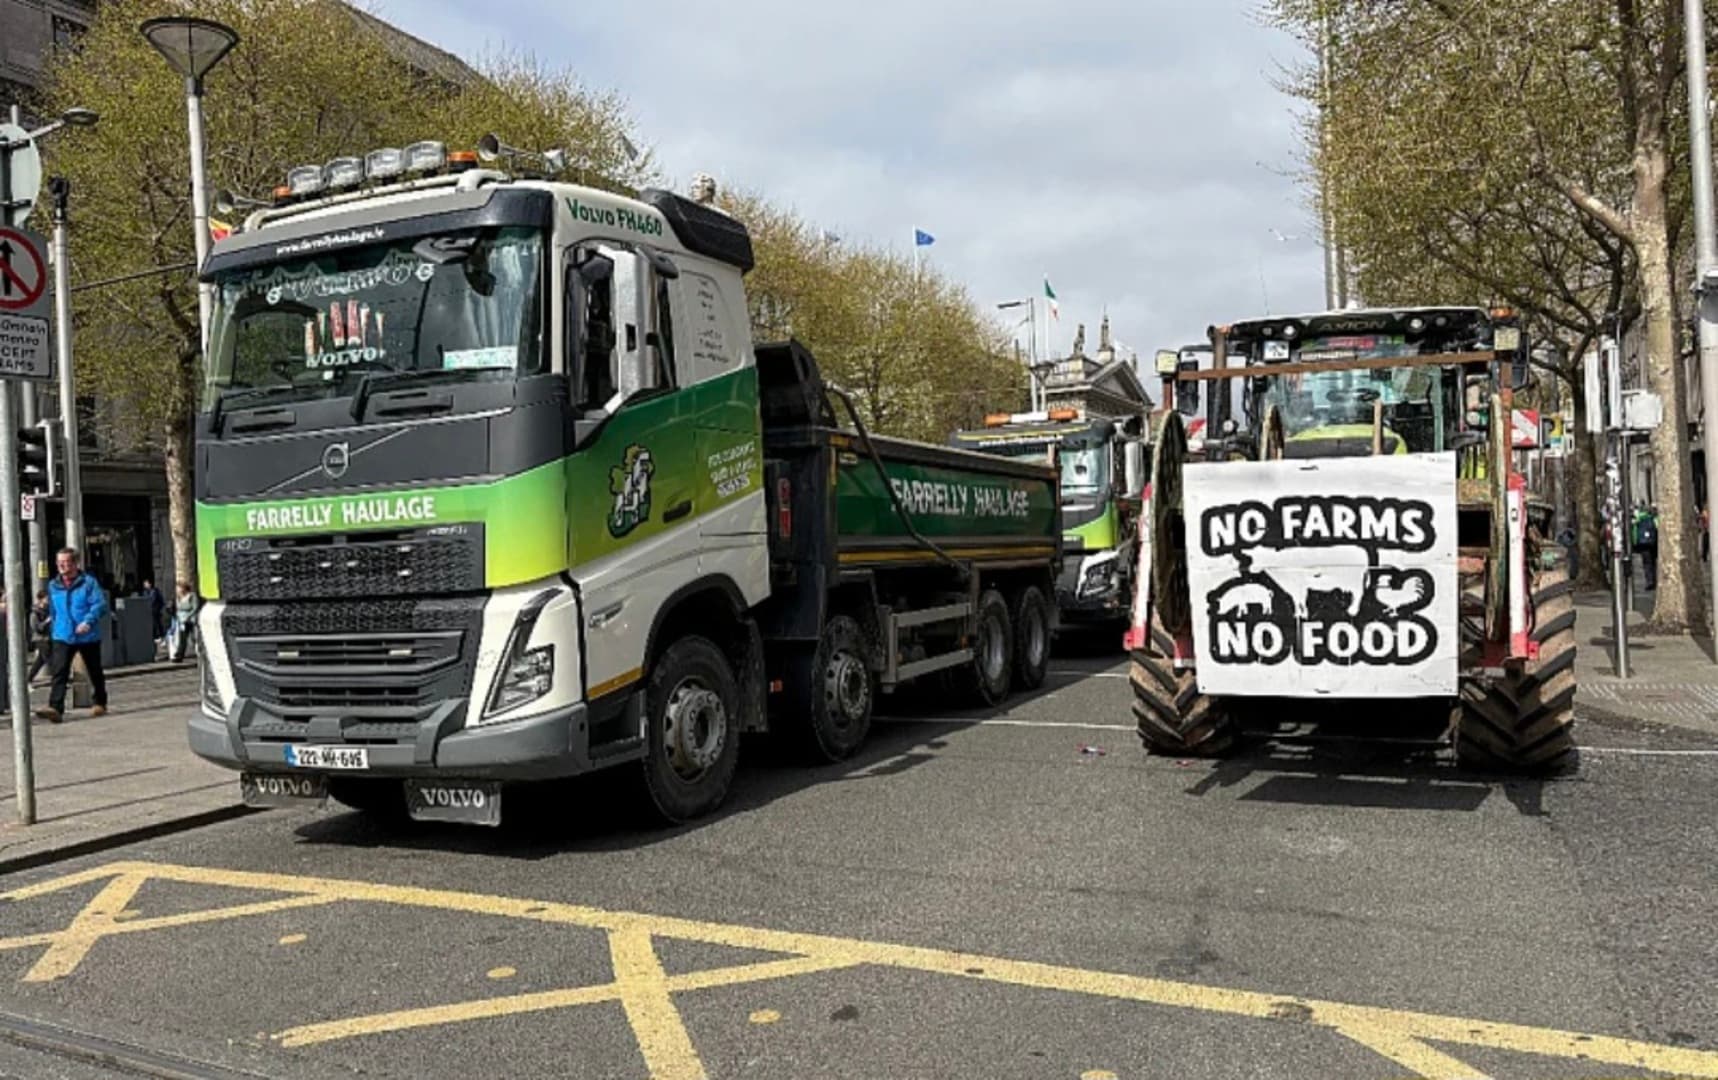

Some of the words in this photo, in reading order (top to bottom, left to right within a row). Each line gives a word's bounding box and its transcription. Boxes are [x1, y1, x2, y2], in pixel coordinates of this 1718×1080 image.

[616, 207, 663, 236] FH460
[1317, 320, 1387, 332] AXION
[305, 347, 377, 368] VOLVO
[887, 478, 968, 516] FARRELLY
[974, 485, 1030, 517] HAULAGE
[246, 503, 334, 531] FARRELLY
[341, 496, 436, 524] HAULAGE
[1208, 508, 1268, 549] NO
[1281, 503, 1426, 544] FARMS
[1217, 621, 1284, 657] NO
[1302, 620, 1429, 658] FOOD
[254, 776, 313, 796] VOLVO
[419, 788, 485, 808] VOLVO
